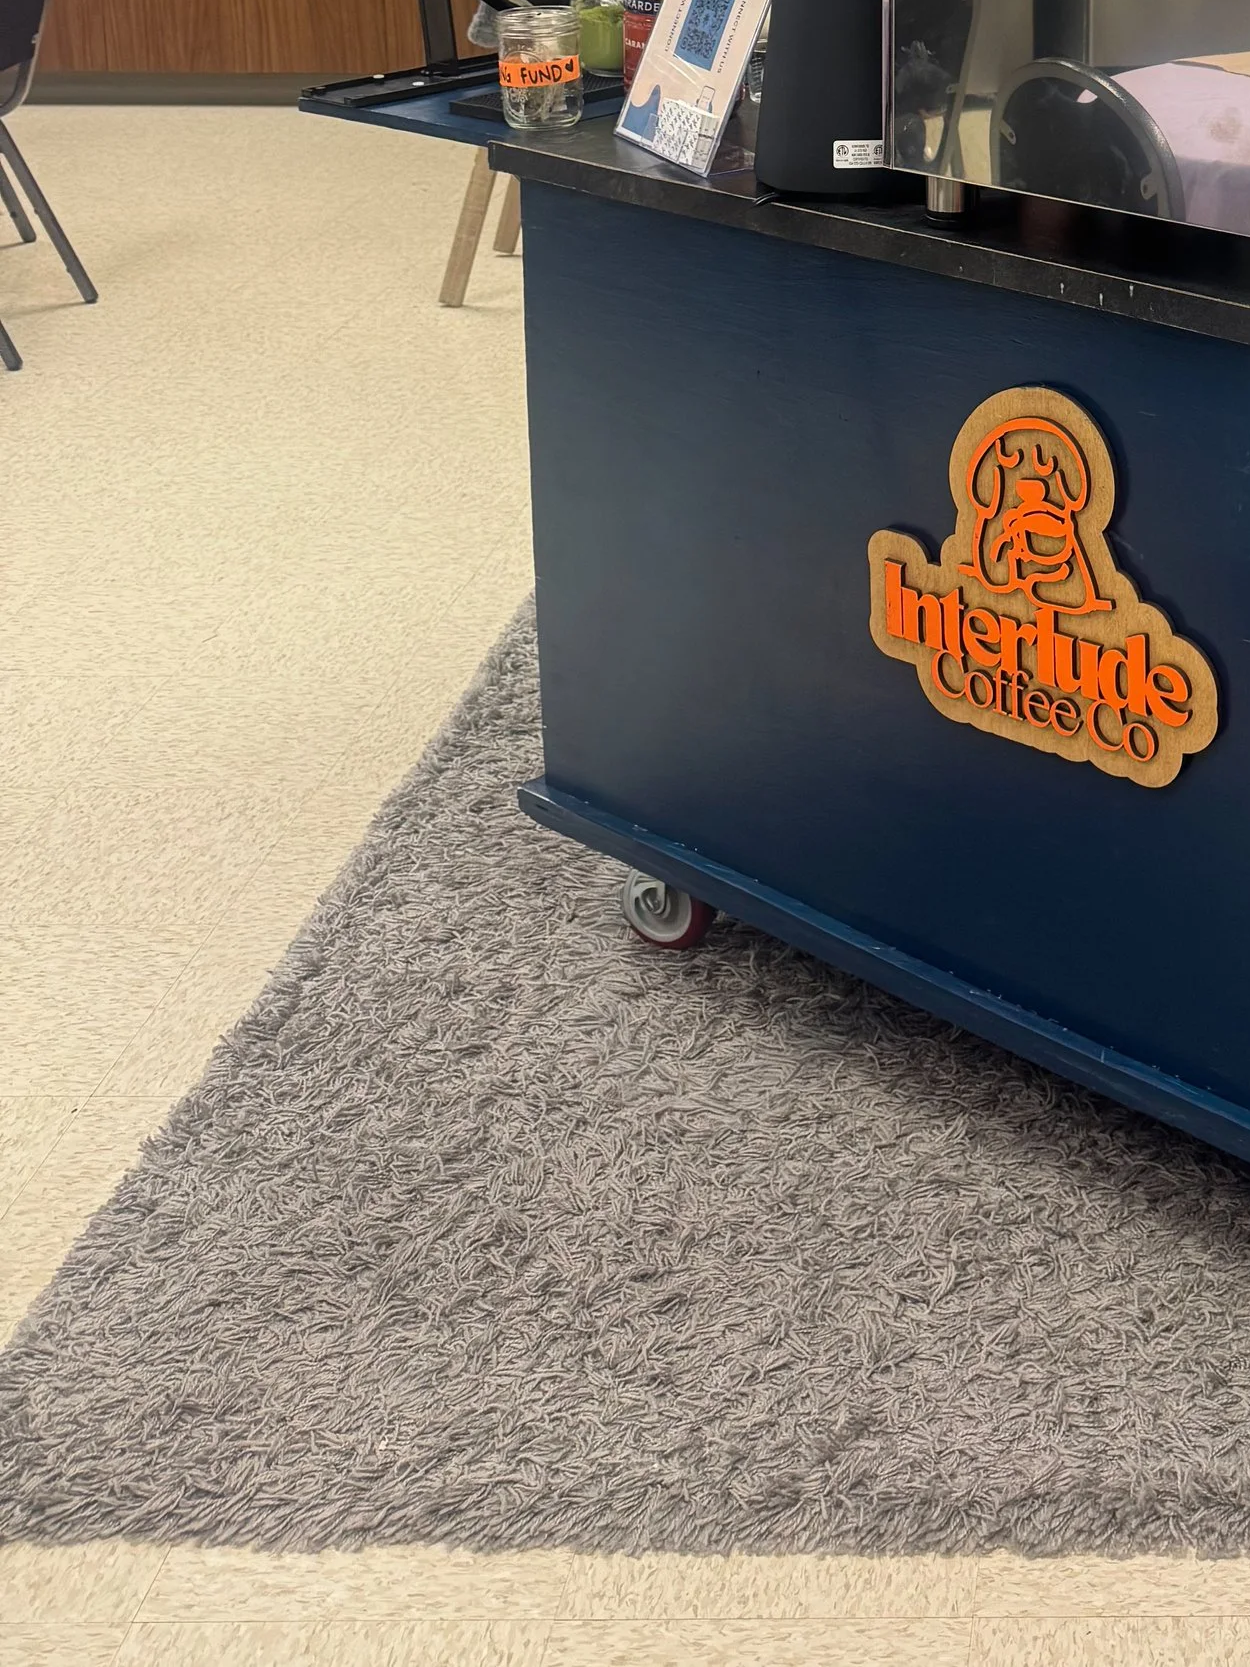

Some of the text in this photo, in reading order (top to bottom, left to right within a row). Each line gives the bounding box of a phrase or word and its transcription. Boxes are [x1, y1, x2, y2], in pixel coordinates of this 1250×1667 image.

[520, 65, 562, 85] FUND
[722, 33, 735, 63] WITH
[884, 557, 1193, 728] Interlude
[931, 648, 1159, 763] Coffee Co
